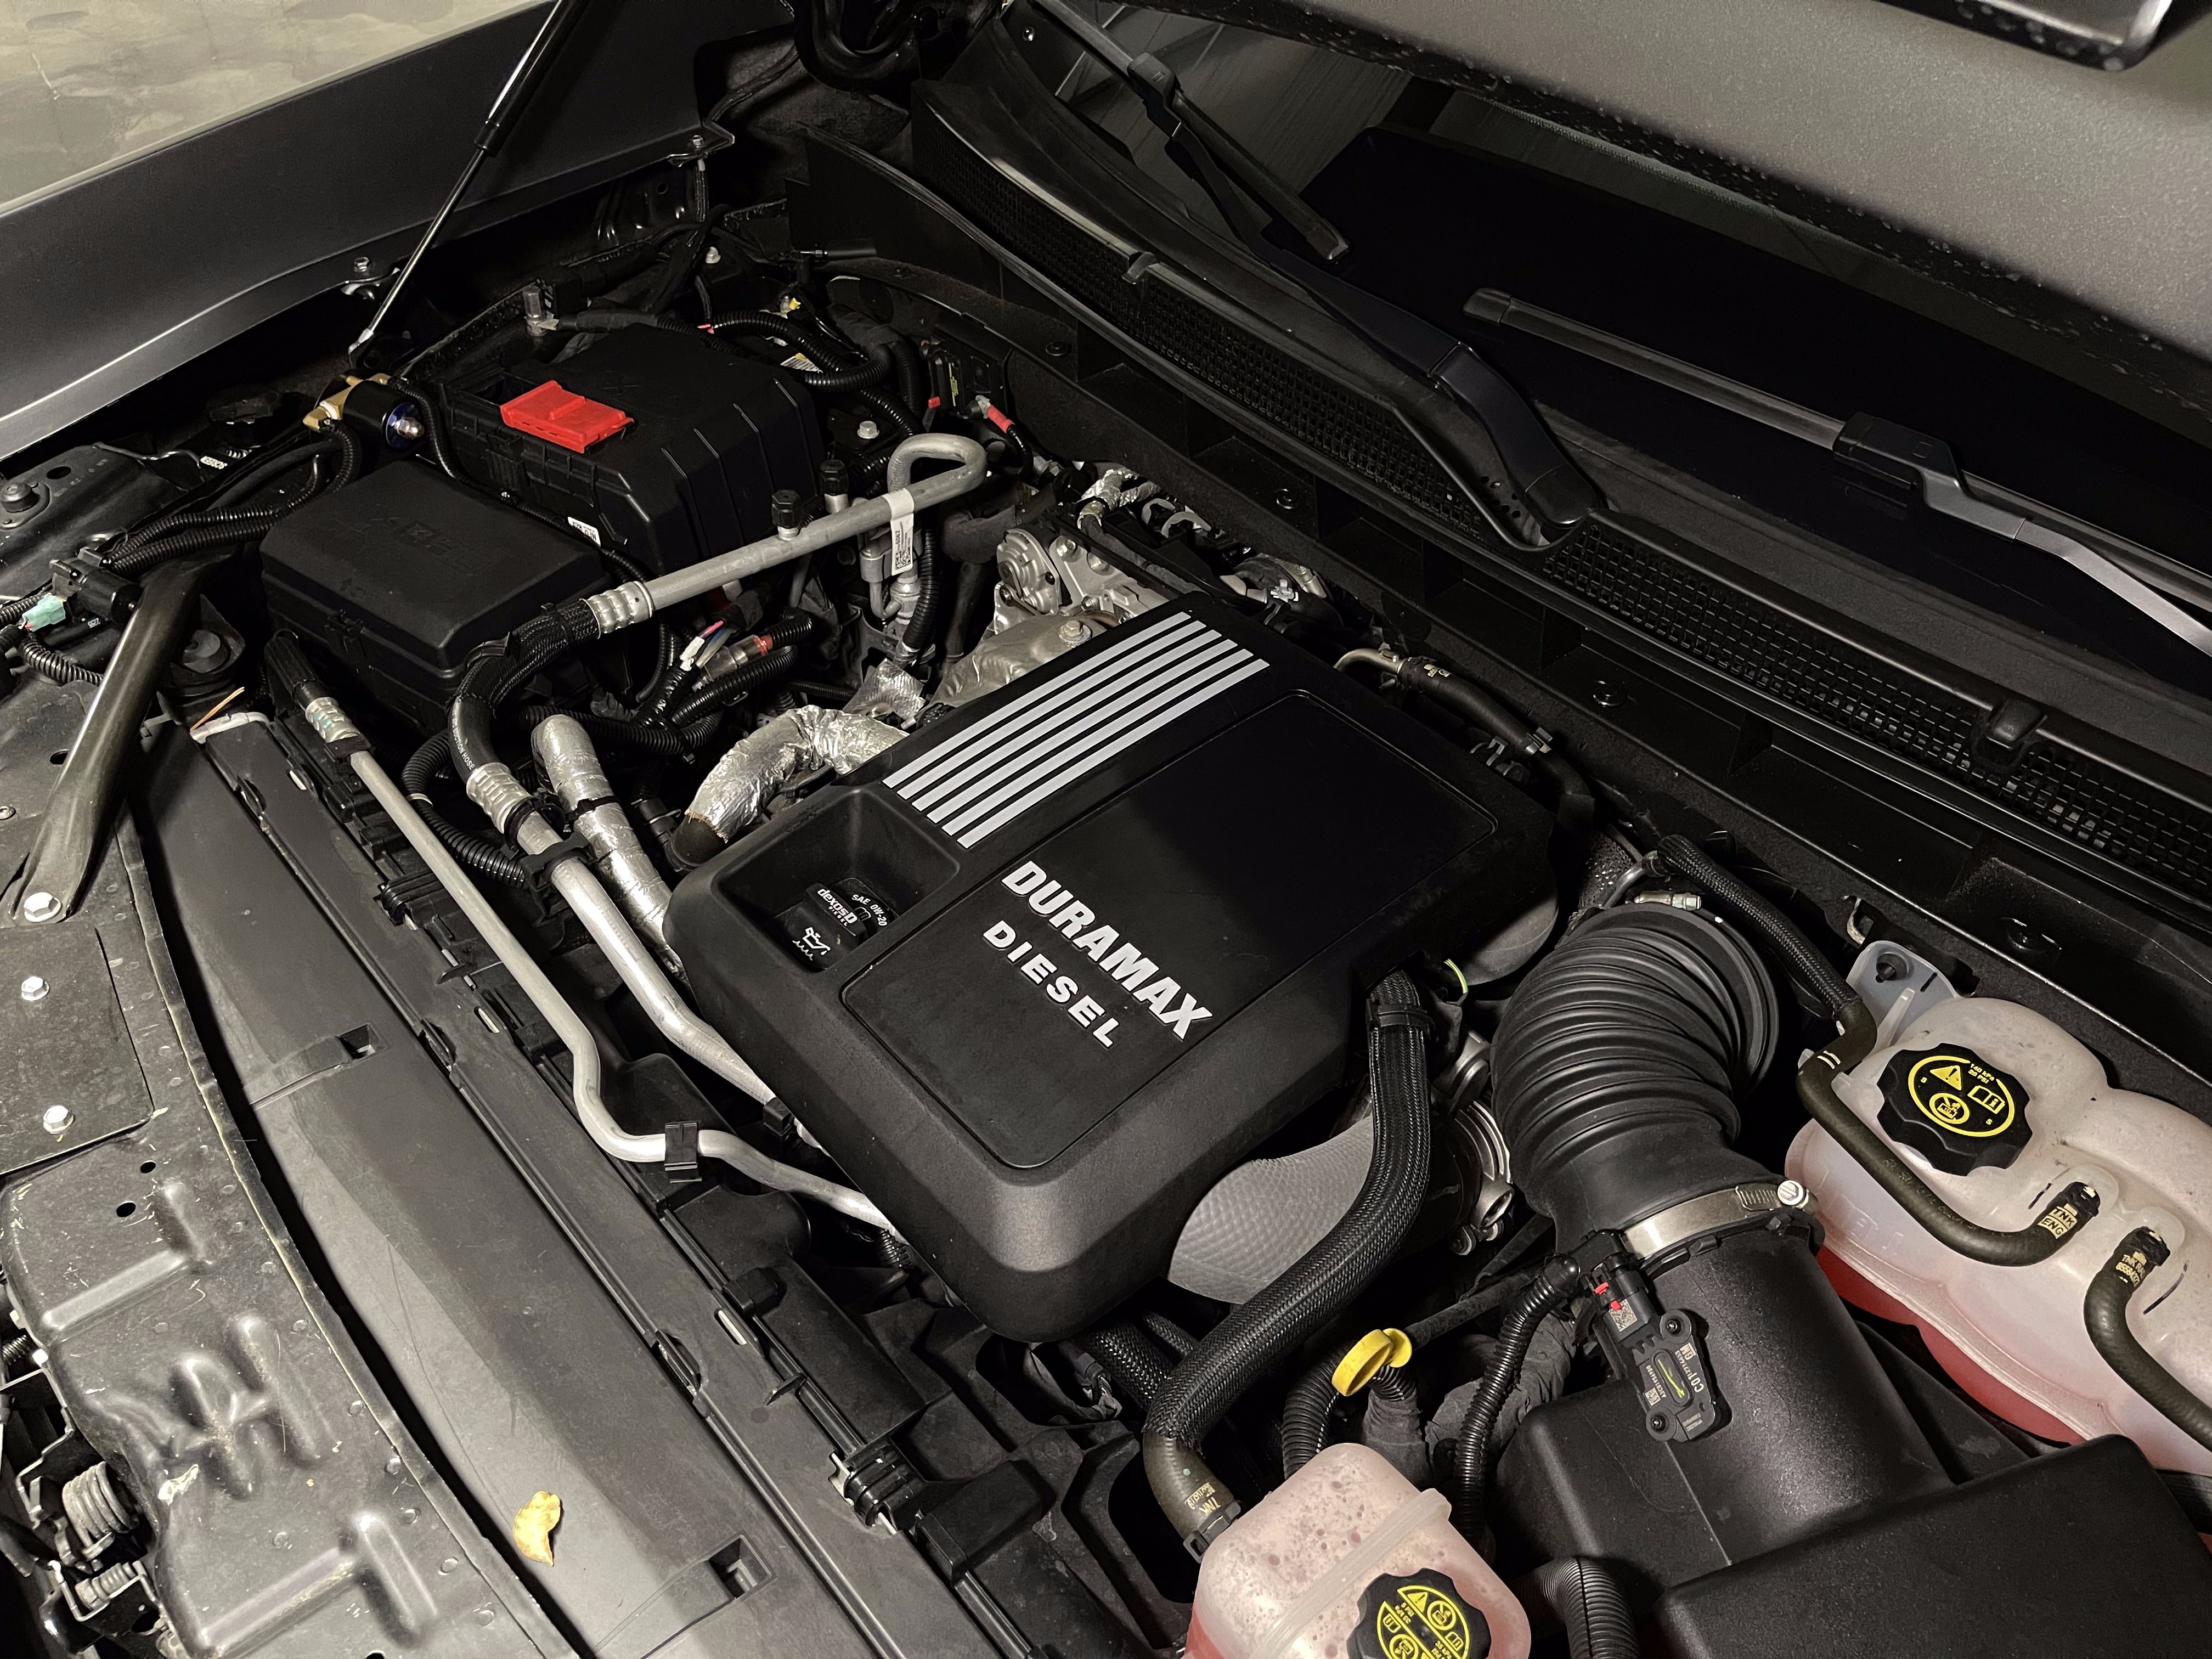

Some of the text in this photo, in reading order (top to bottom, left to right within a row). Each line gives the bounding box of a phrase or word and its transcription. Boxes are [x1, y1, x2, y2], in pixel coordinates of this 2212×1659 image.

[461, 752, 475, 770] HOSE
[851, 894, 888, 926] SAE 0W-20
[1001, 860, 1212, 1041] DURAMAX
[983, 920, 1120, 1048] DIESEL
[1968, 1069, 1989, 1084] 20 PSI
[1970, 1063, 1995, 1081] 140 kPa
[2042, 1217, 2064, 1235] ENG
[2052, 1208, 2076, 1227] TNK
[2121, 1254, 2137, 1268] TNK
[1679, 1343, 1695, 1361] GM
[1688, 1372, 1705, 1392] C01
[1404, 1606, 1414, 1617] PSI
